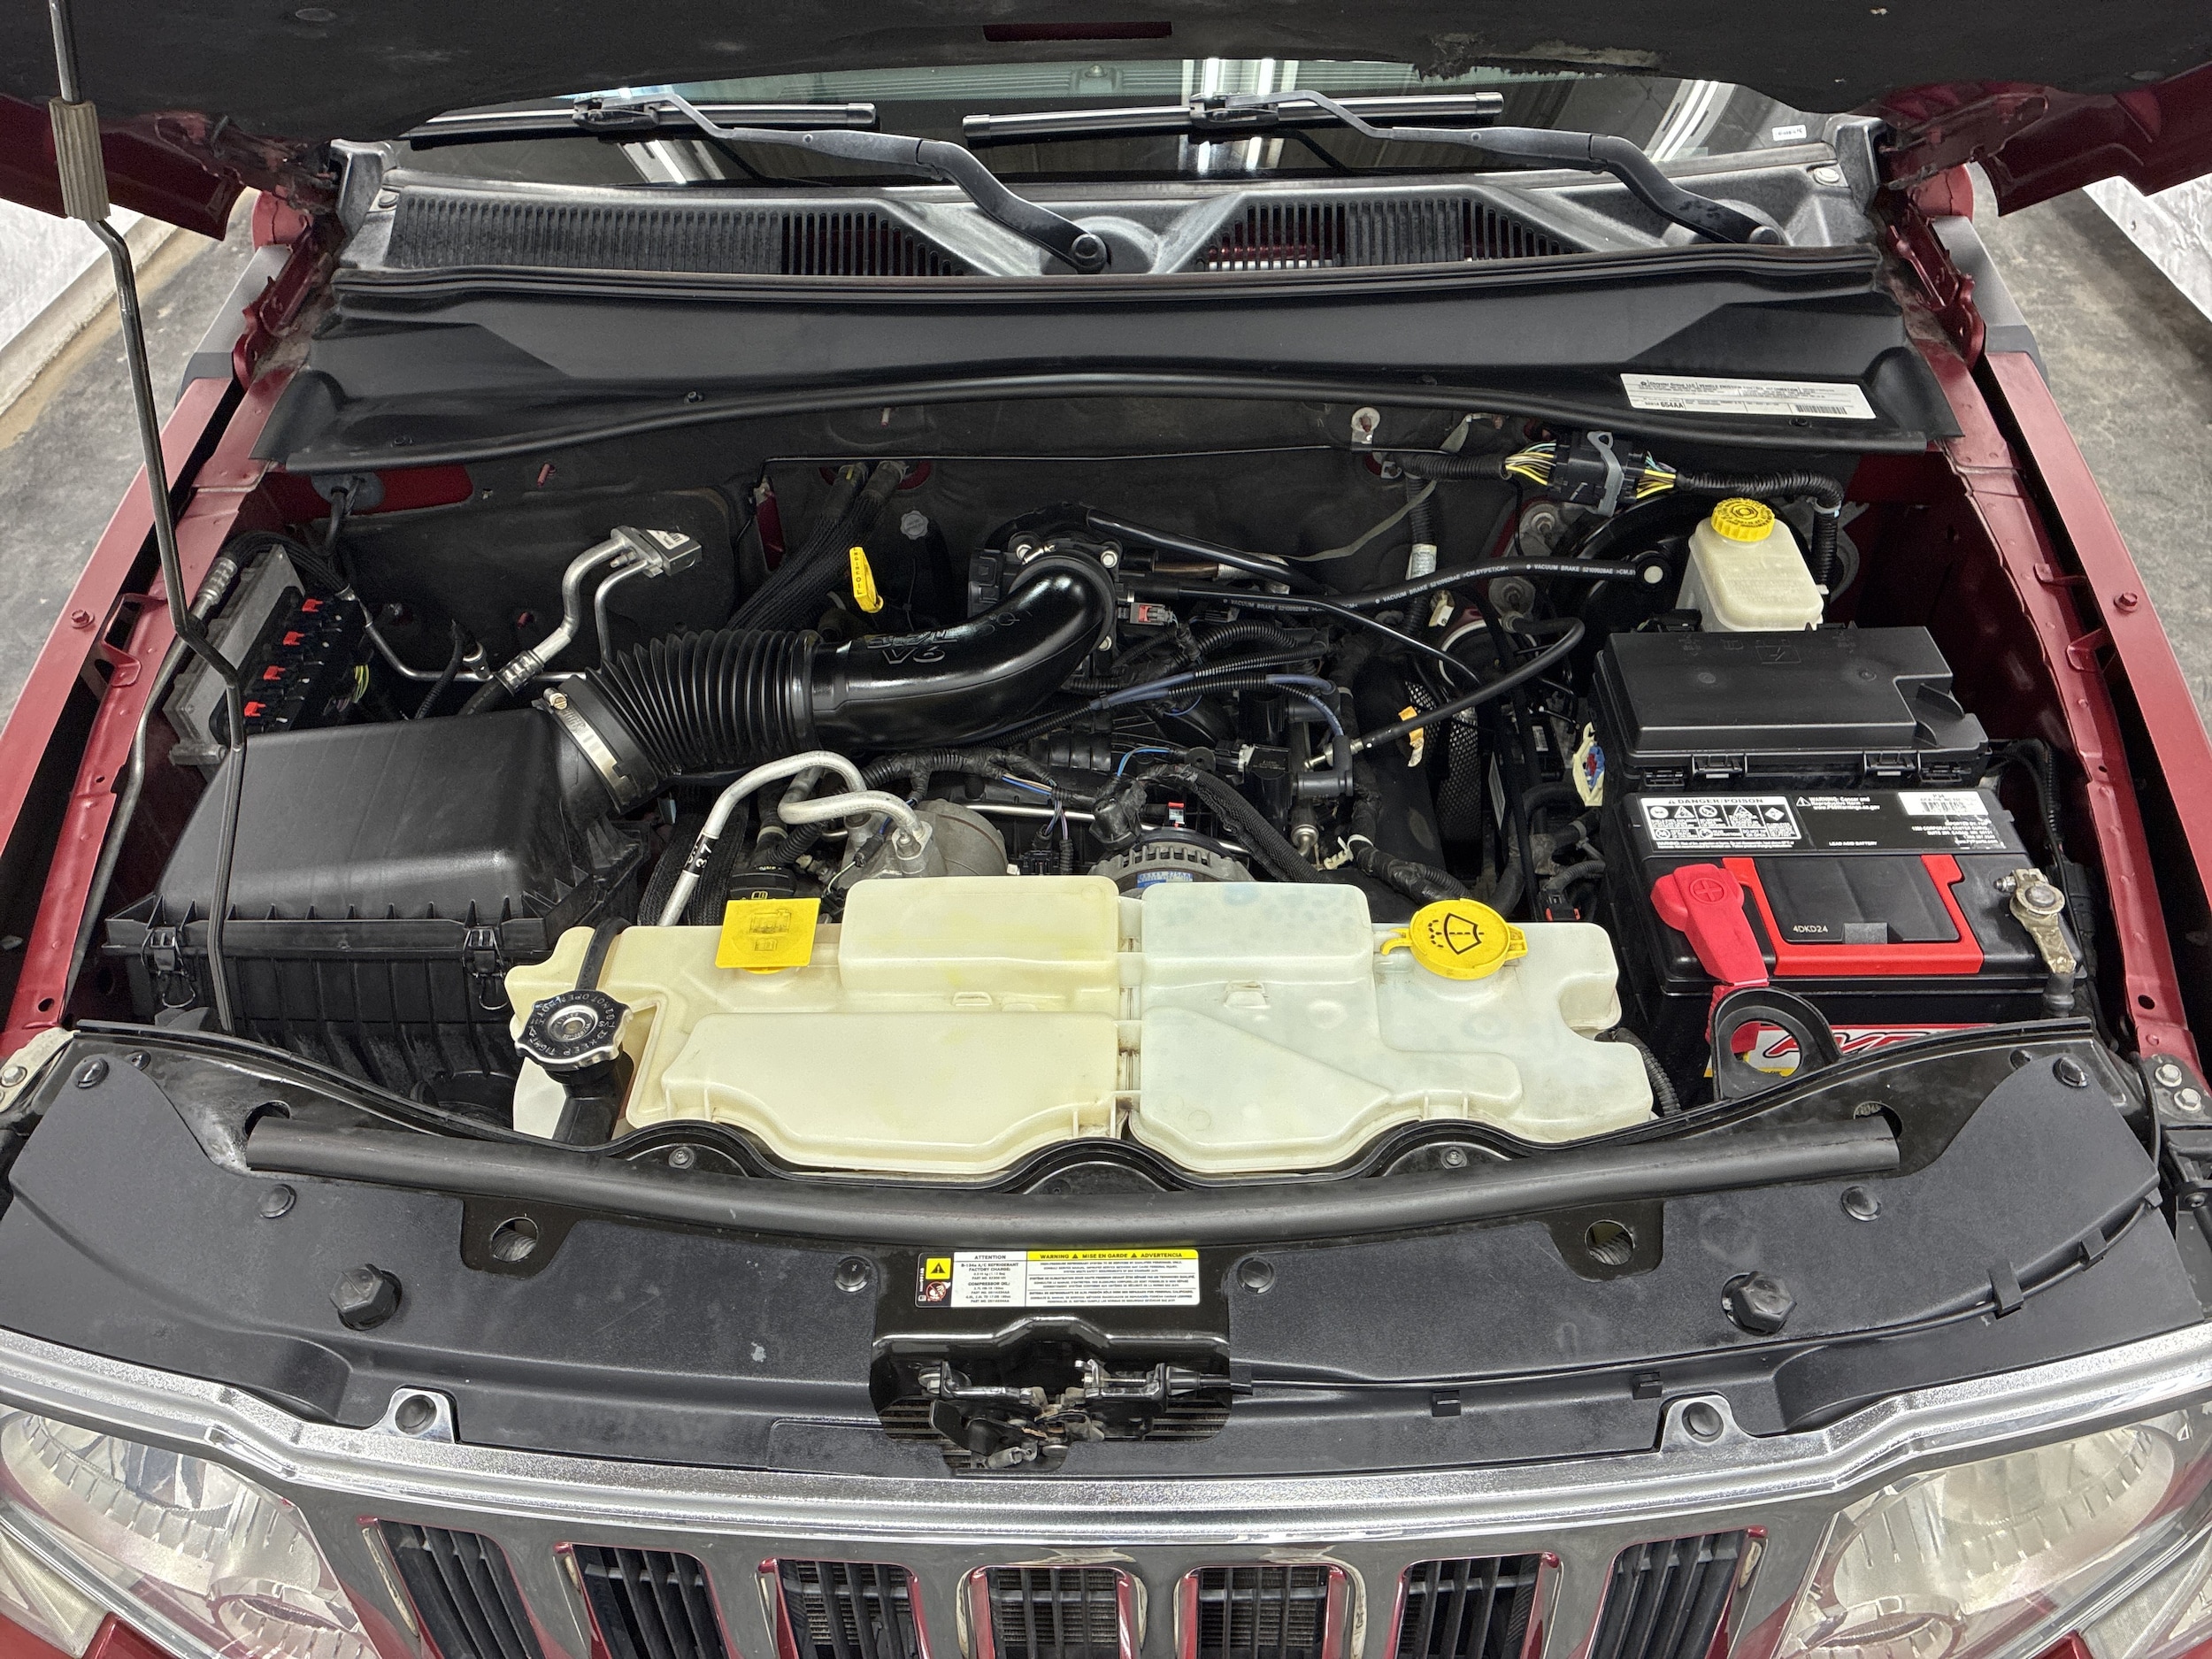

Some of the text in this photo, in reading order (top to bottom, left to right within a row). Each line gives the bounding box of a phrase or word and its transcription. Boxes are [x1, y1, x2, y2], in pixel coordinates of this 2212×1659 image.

[1382, 591, 1407, 603] VACUUM
[1409, 584, 1429, 595] BRAKE
[882, 645, 946, 665] V6
[1792, 925, 1829, 934] 4DKD24
